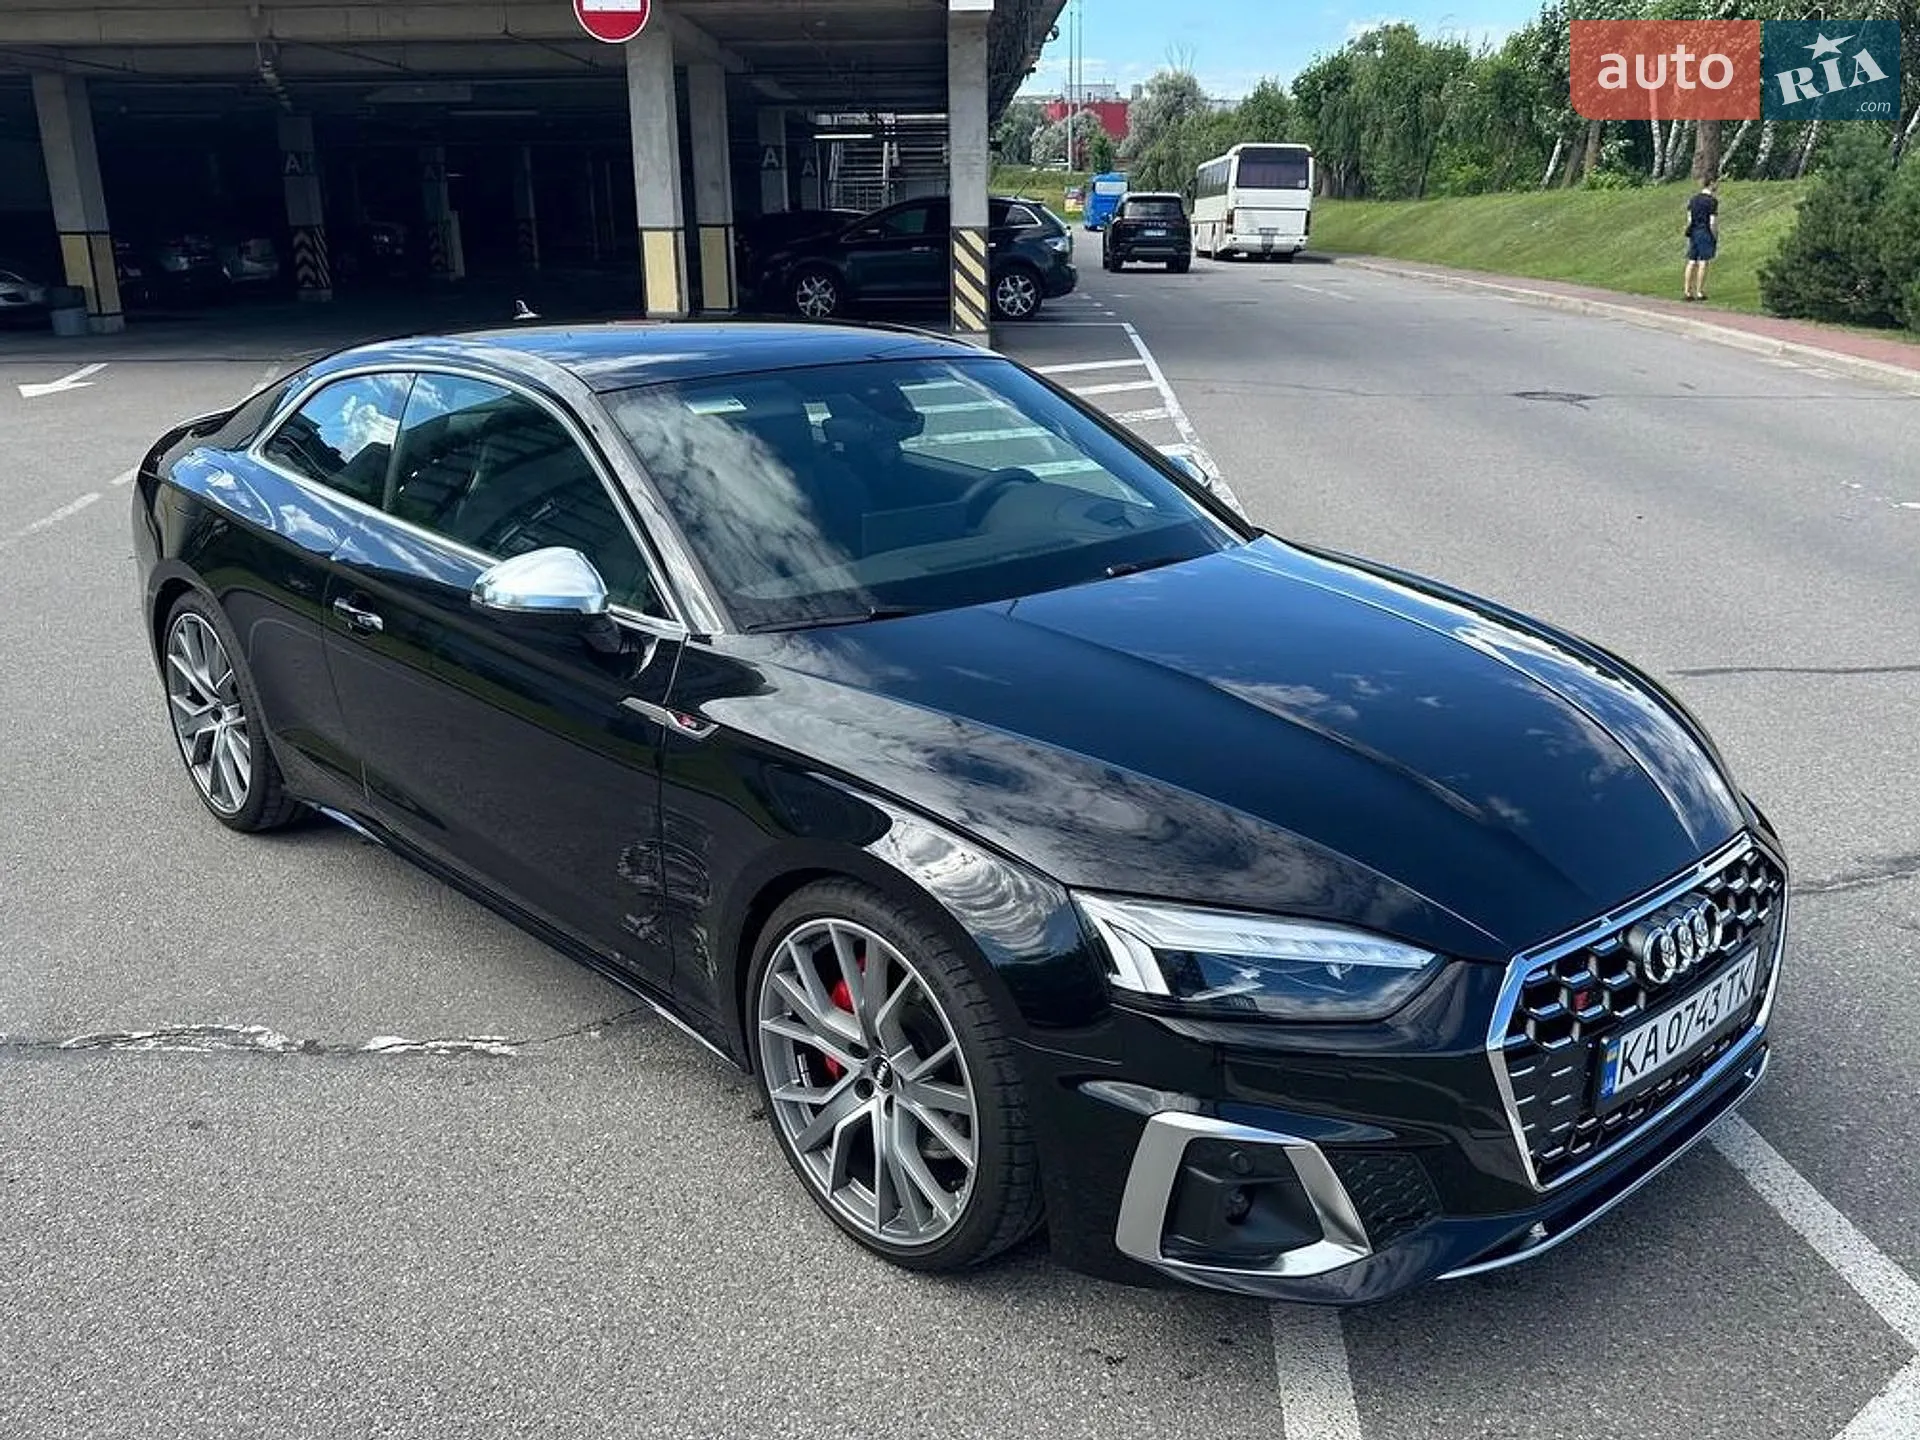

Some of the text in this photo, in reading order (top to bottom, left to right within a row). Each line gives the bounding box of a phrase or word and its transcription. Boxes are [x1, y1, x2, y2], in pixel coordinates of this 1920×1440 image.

[1619, 955, 1755, 1085] KA 0743 TK
